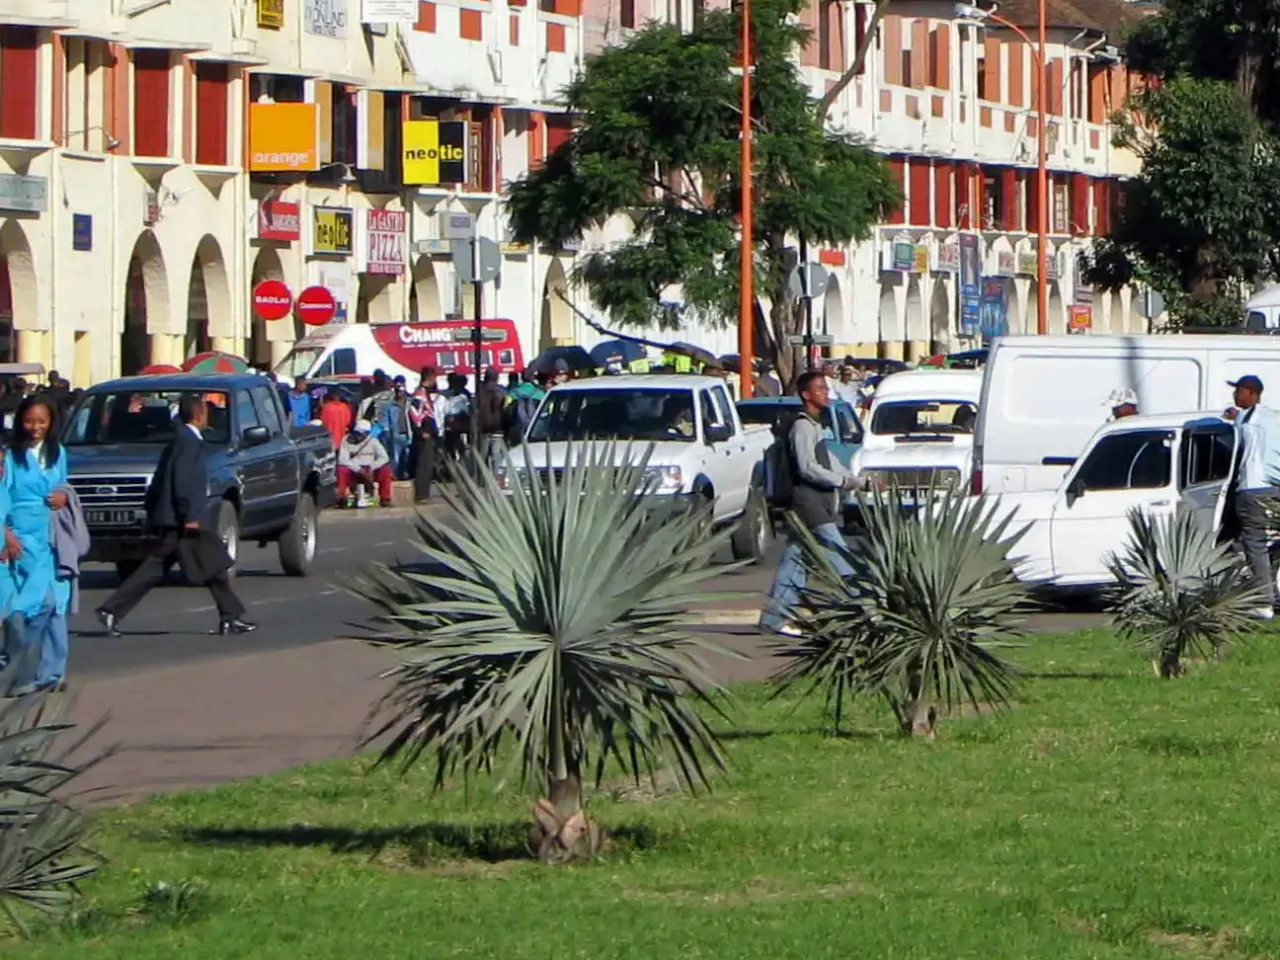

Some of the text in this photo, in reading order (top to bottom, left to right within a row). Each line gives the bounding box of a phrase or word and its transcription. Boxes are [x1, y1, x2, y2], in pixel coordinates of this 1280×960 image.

[254, 150, 308, 166] orange
[405, 144, 463, 160] neotic
[369, 232, 403, 262] PIZZA
